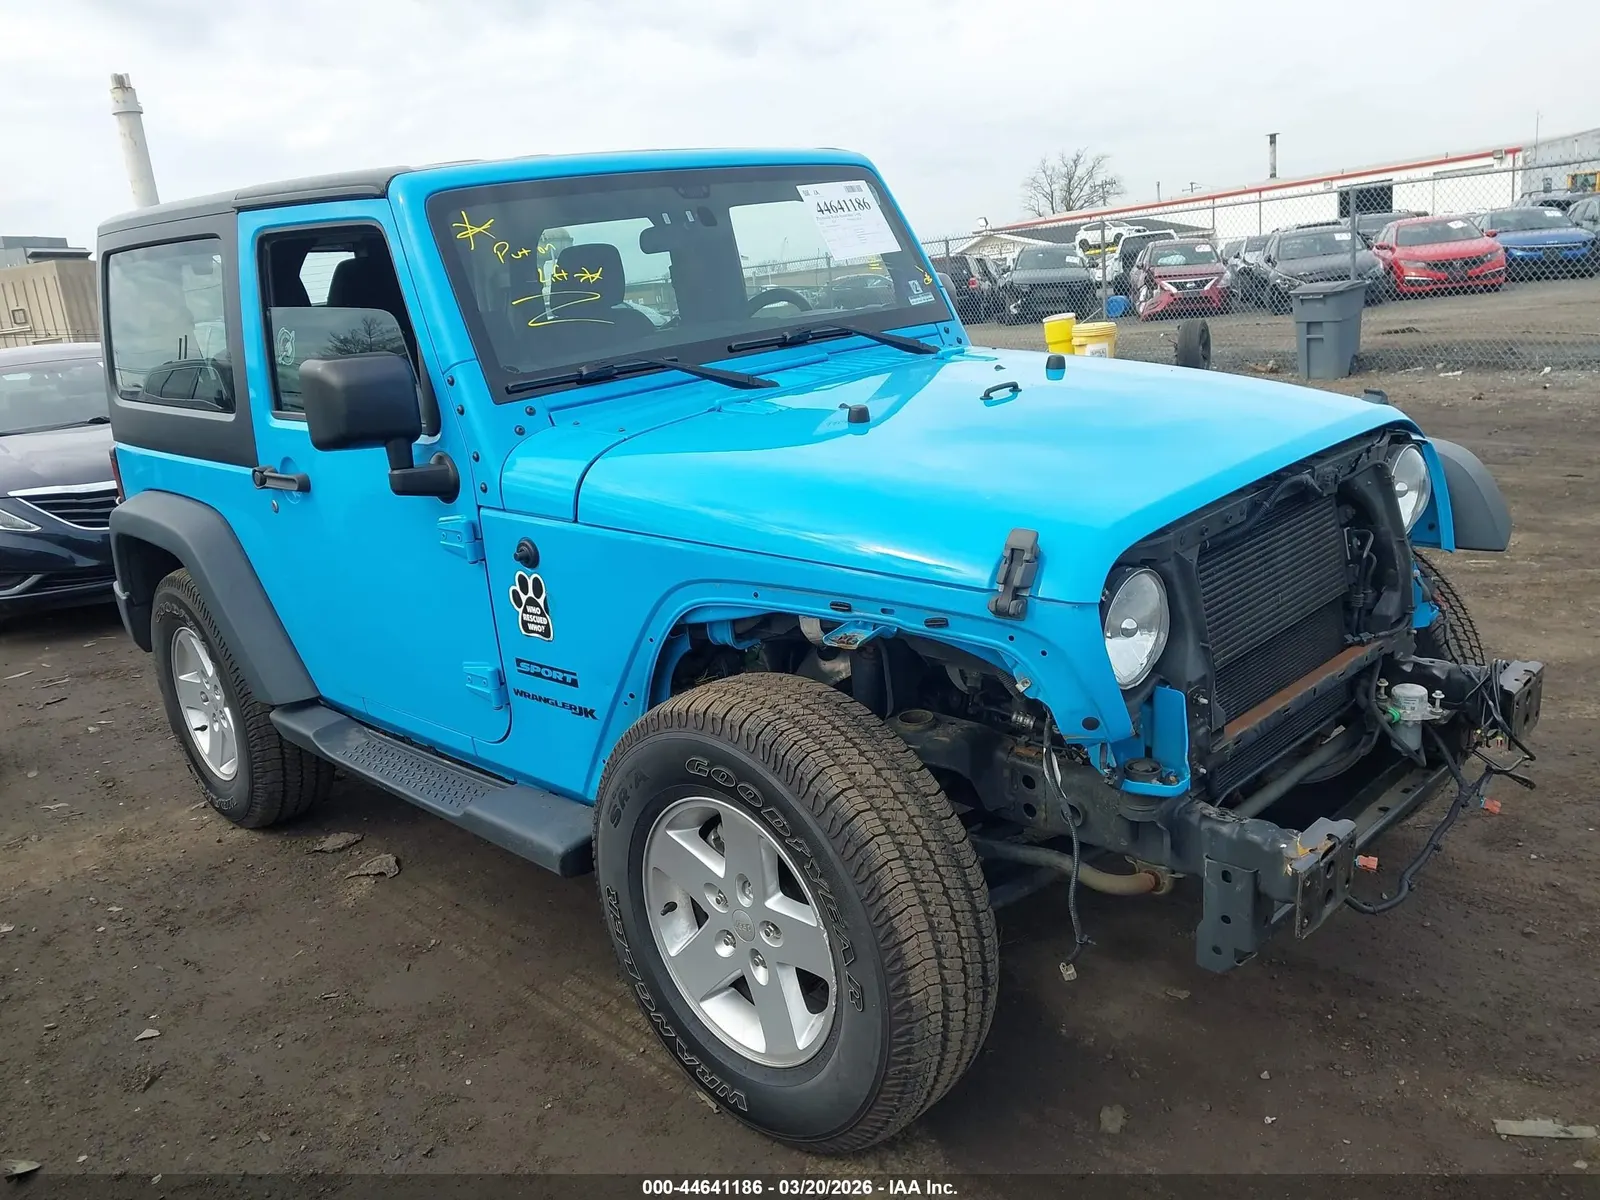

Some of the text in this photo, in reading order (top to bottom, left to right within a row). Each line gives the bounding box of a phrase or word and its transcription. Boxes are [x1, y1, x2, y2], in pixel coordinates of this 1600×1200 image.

[816, 197, 872, 215] 44641186
[493, 241, 532, 264] Put
[522, 613, 548, 625] RESCUED
[525, 605, 541, 615] WHO
[527, 622, 545, 633] WHO?
[519, 661, 577, 684] SPORT
[685, 757, 863, 1012] GOODYEAR
[605, 885, 748, 1112] WRANGLER
